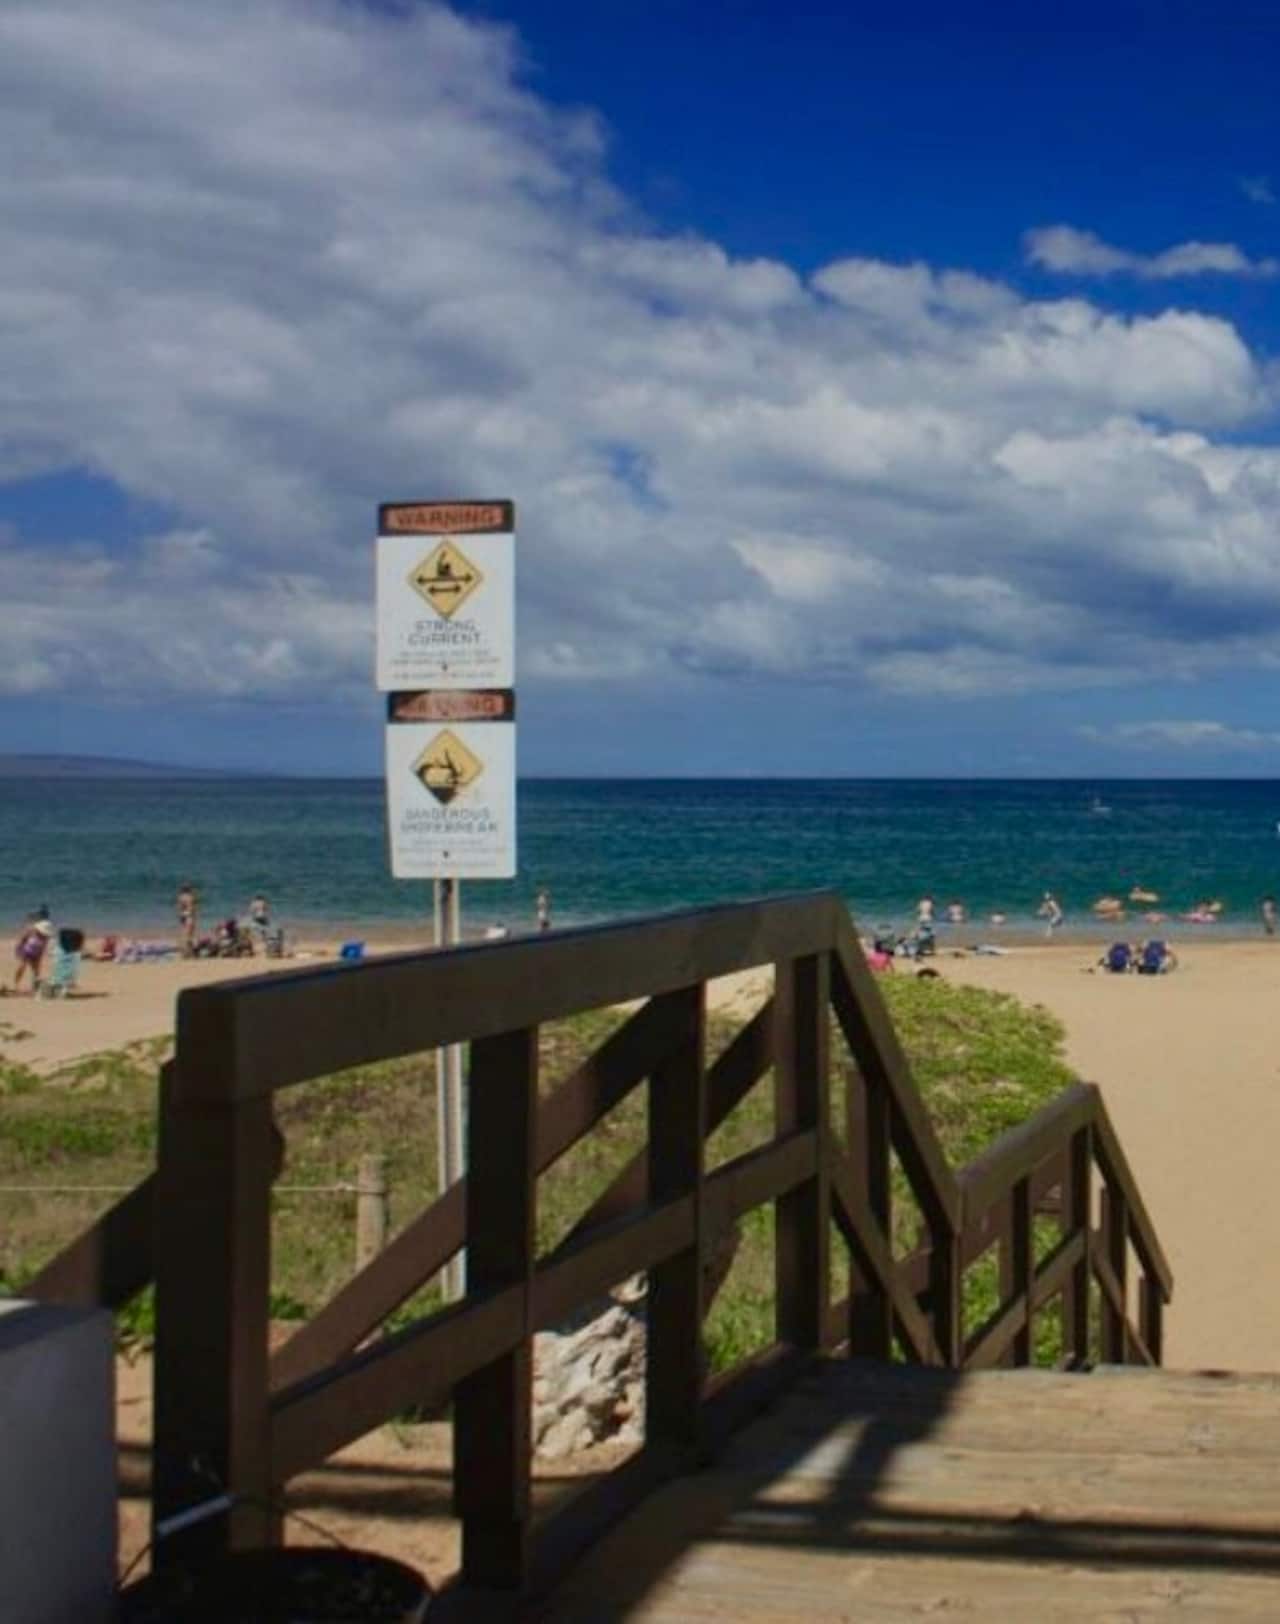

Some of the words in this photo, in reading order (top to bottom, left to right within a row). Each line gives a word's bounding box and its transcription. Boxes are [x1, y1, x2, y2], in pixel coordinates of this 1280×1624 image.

[397, 509, 496, 526] WARNING
[415, 619, 477, 632] STRONG
[408, 632, 481, 645] CURRENT
